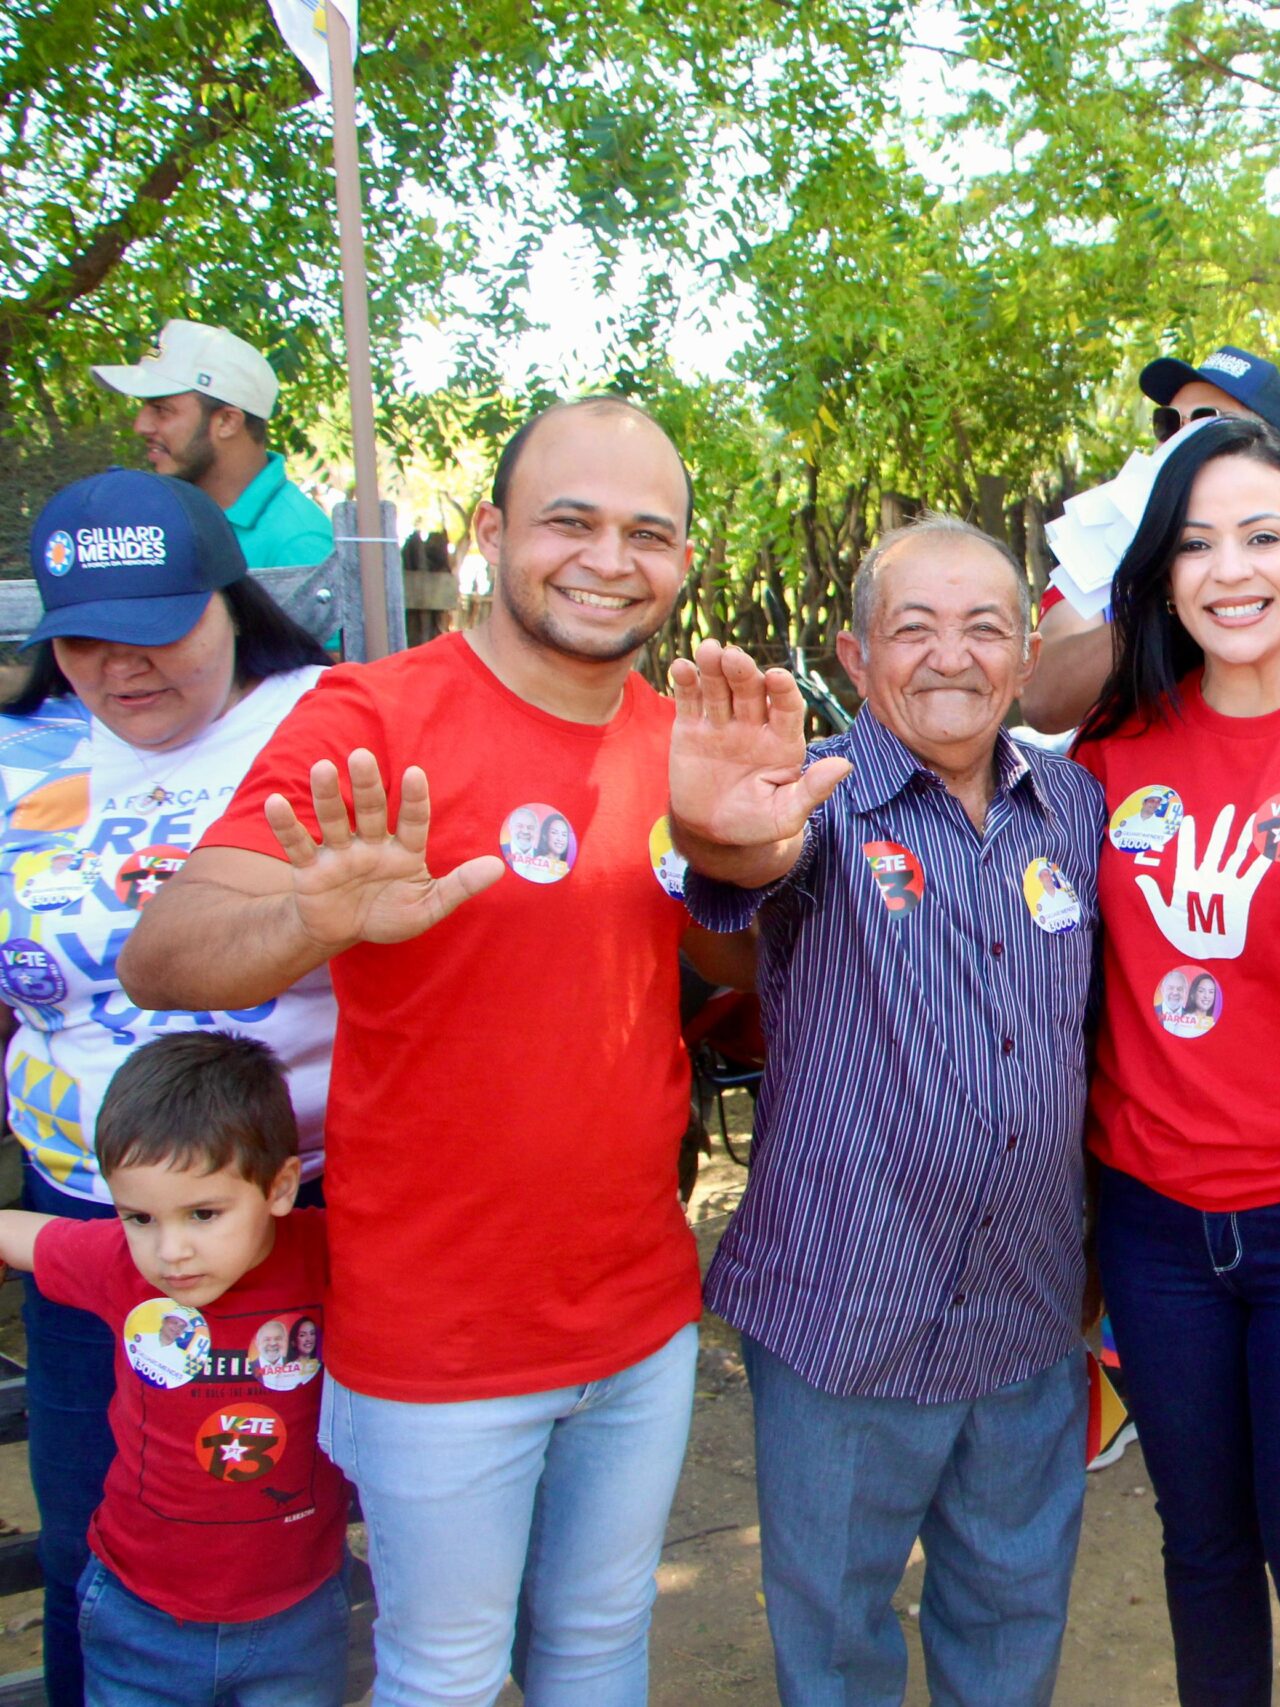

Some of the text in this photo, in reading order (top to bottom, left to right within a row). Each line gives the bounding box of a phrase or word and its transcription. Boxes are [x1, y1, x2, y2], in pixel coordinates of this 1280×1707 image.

[76, 526, 165, 546] GILLIARD
[77, 541, 167, 563] MENDES
[220, 1415, 276, 1434] VOTE
